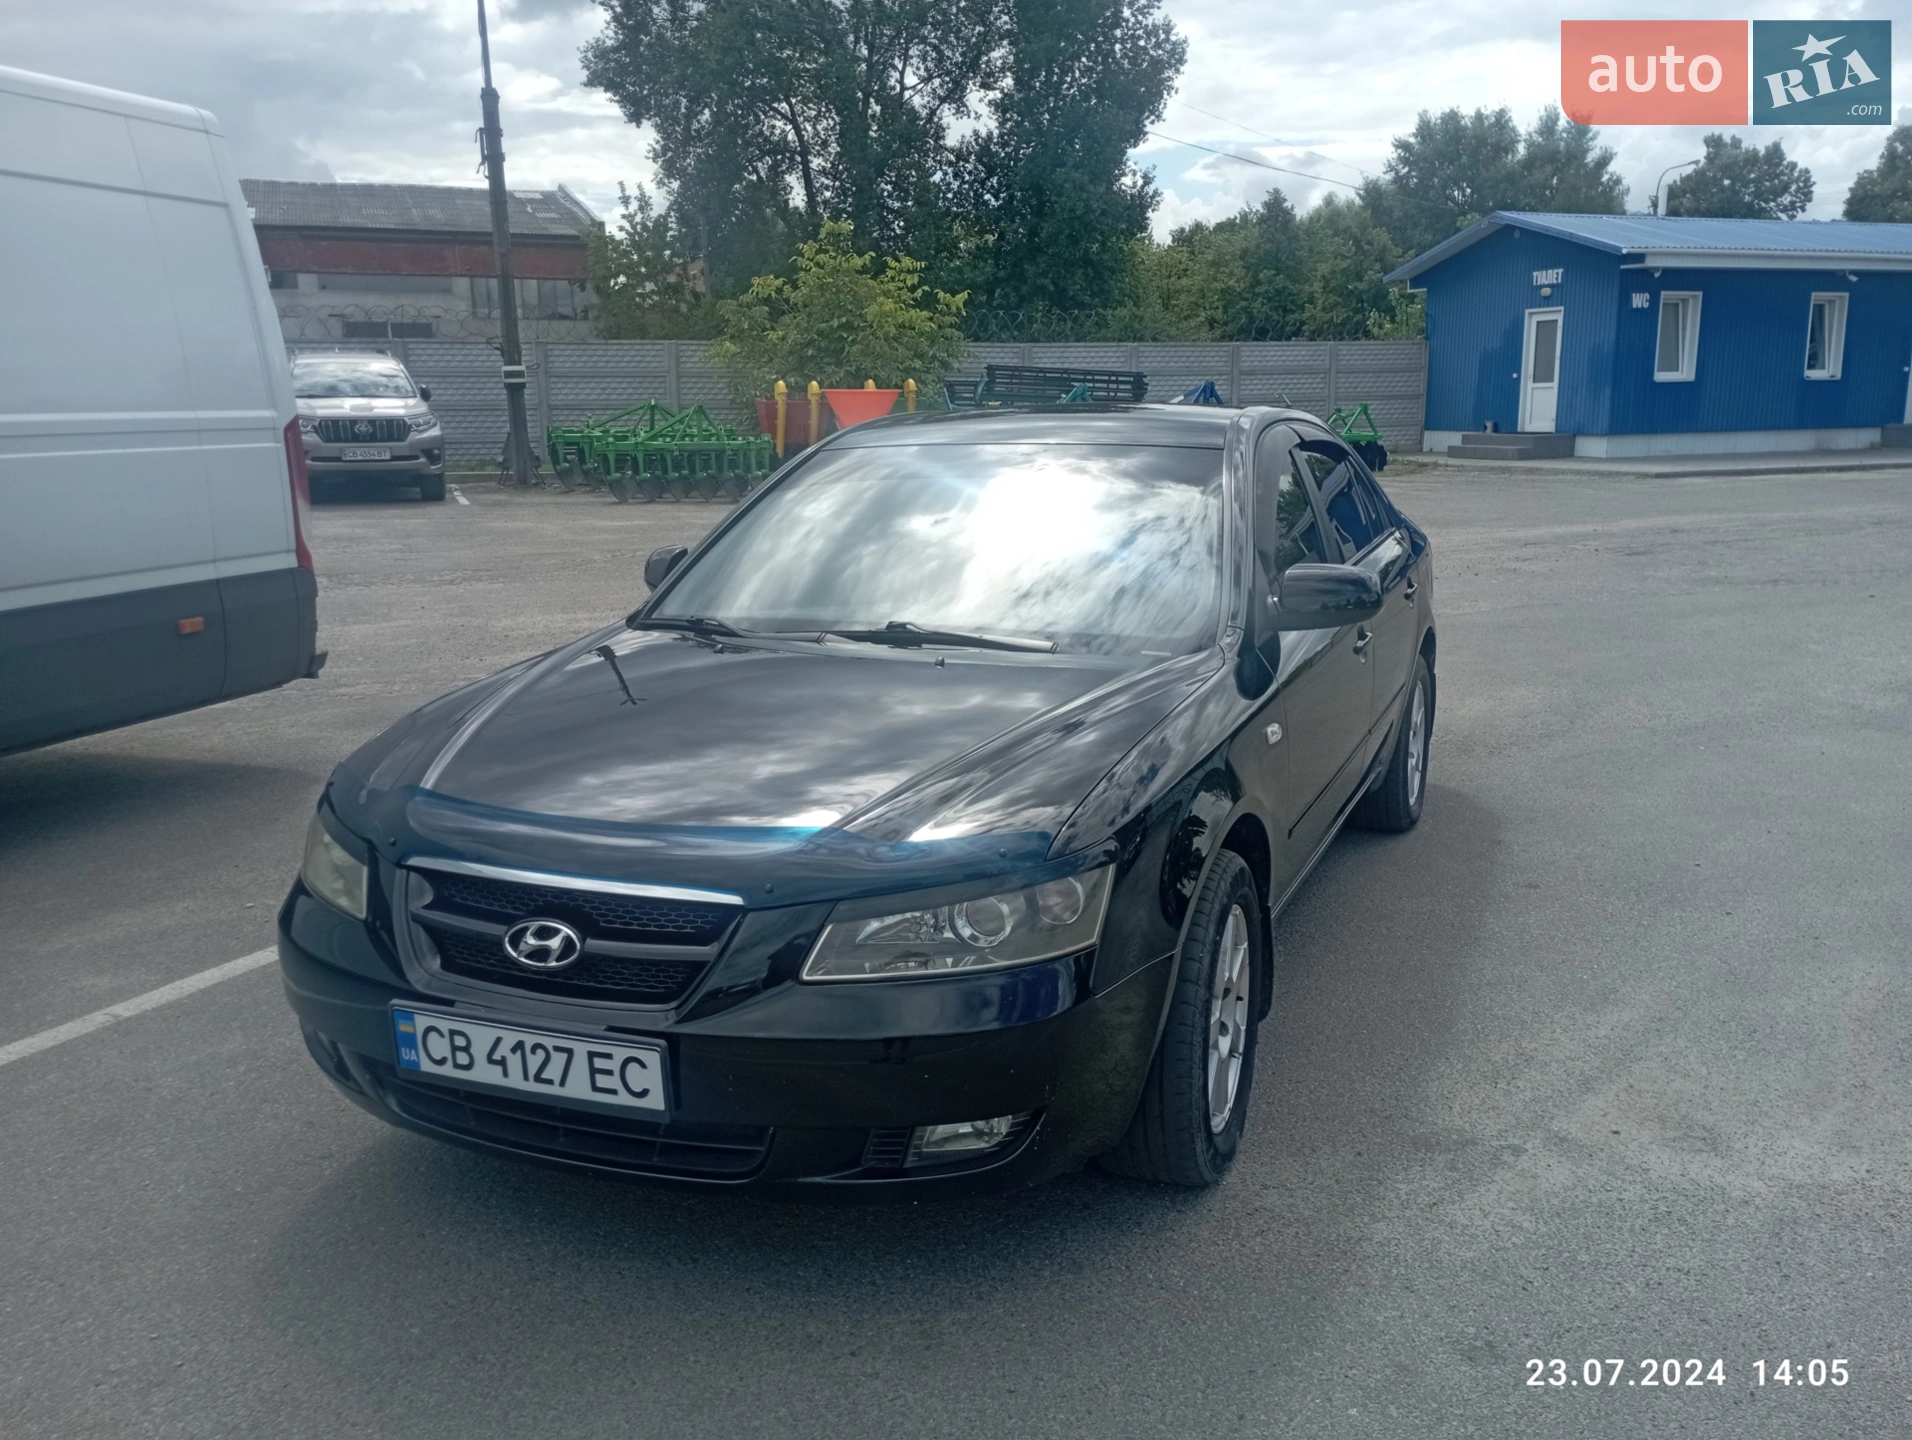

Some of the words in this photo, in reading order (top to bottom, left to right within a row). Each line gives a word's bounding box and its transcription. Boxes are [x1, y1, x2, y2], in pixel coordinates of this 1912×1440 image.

[1532, 268, 1564, 286] ТУАЛЕТ
[1632, 292, 1650, 308] WC
[401, 1047, 418, 1062] UA
[420, 1025, 475, 1071] CB
[486, 1036, 575, 1088] 4127
[586, 1049, 650, 1099] EC
